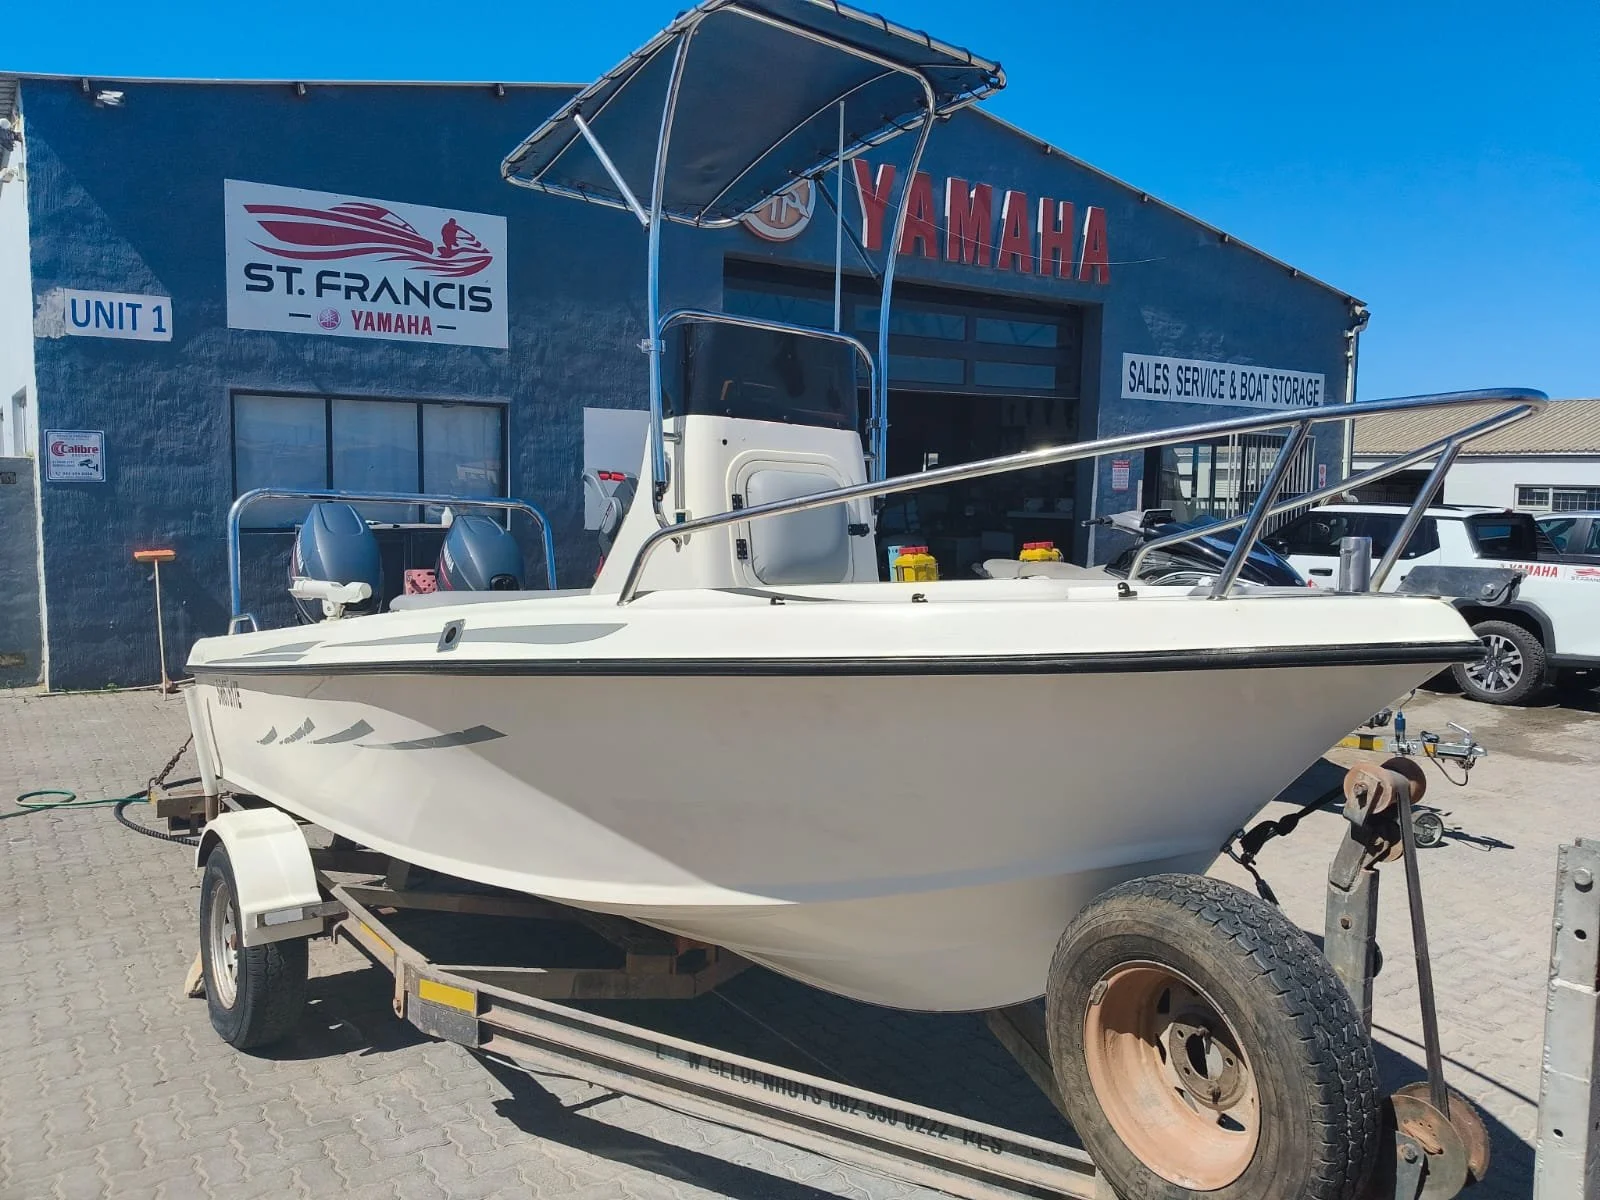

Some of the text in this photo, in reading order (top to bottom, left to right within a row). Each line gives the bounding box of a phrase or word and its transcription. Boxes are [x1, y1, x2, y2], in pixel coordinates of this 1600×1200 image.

[852, 159, 1110, 285] YAMAHA
[71, 298, 167, 333] UNIT 1
[351, 309, 433, 336] YAMAHA
[1128, 360, 1320, 406] SALES, SERVICE & BOAT STORAGE
[61, 444, 99, 454] Calibre
[904, 1112, 950, 1141] 0222
